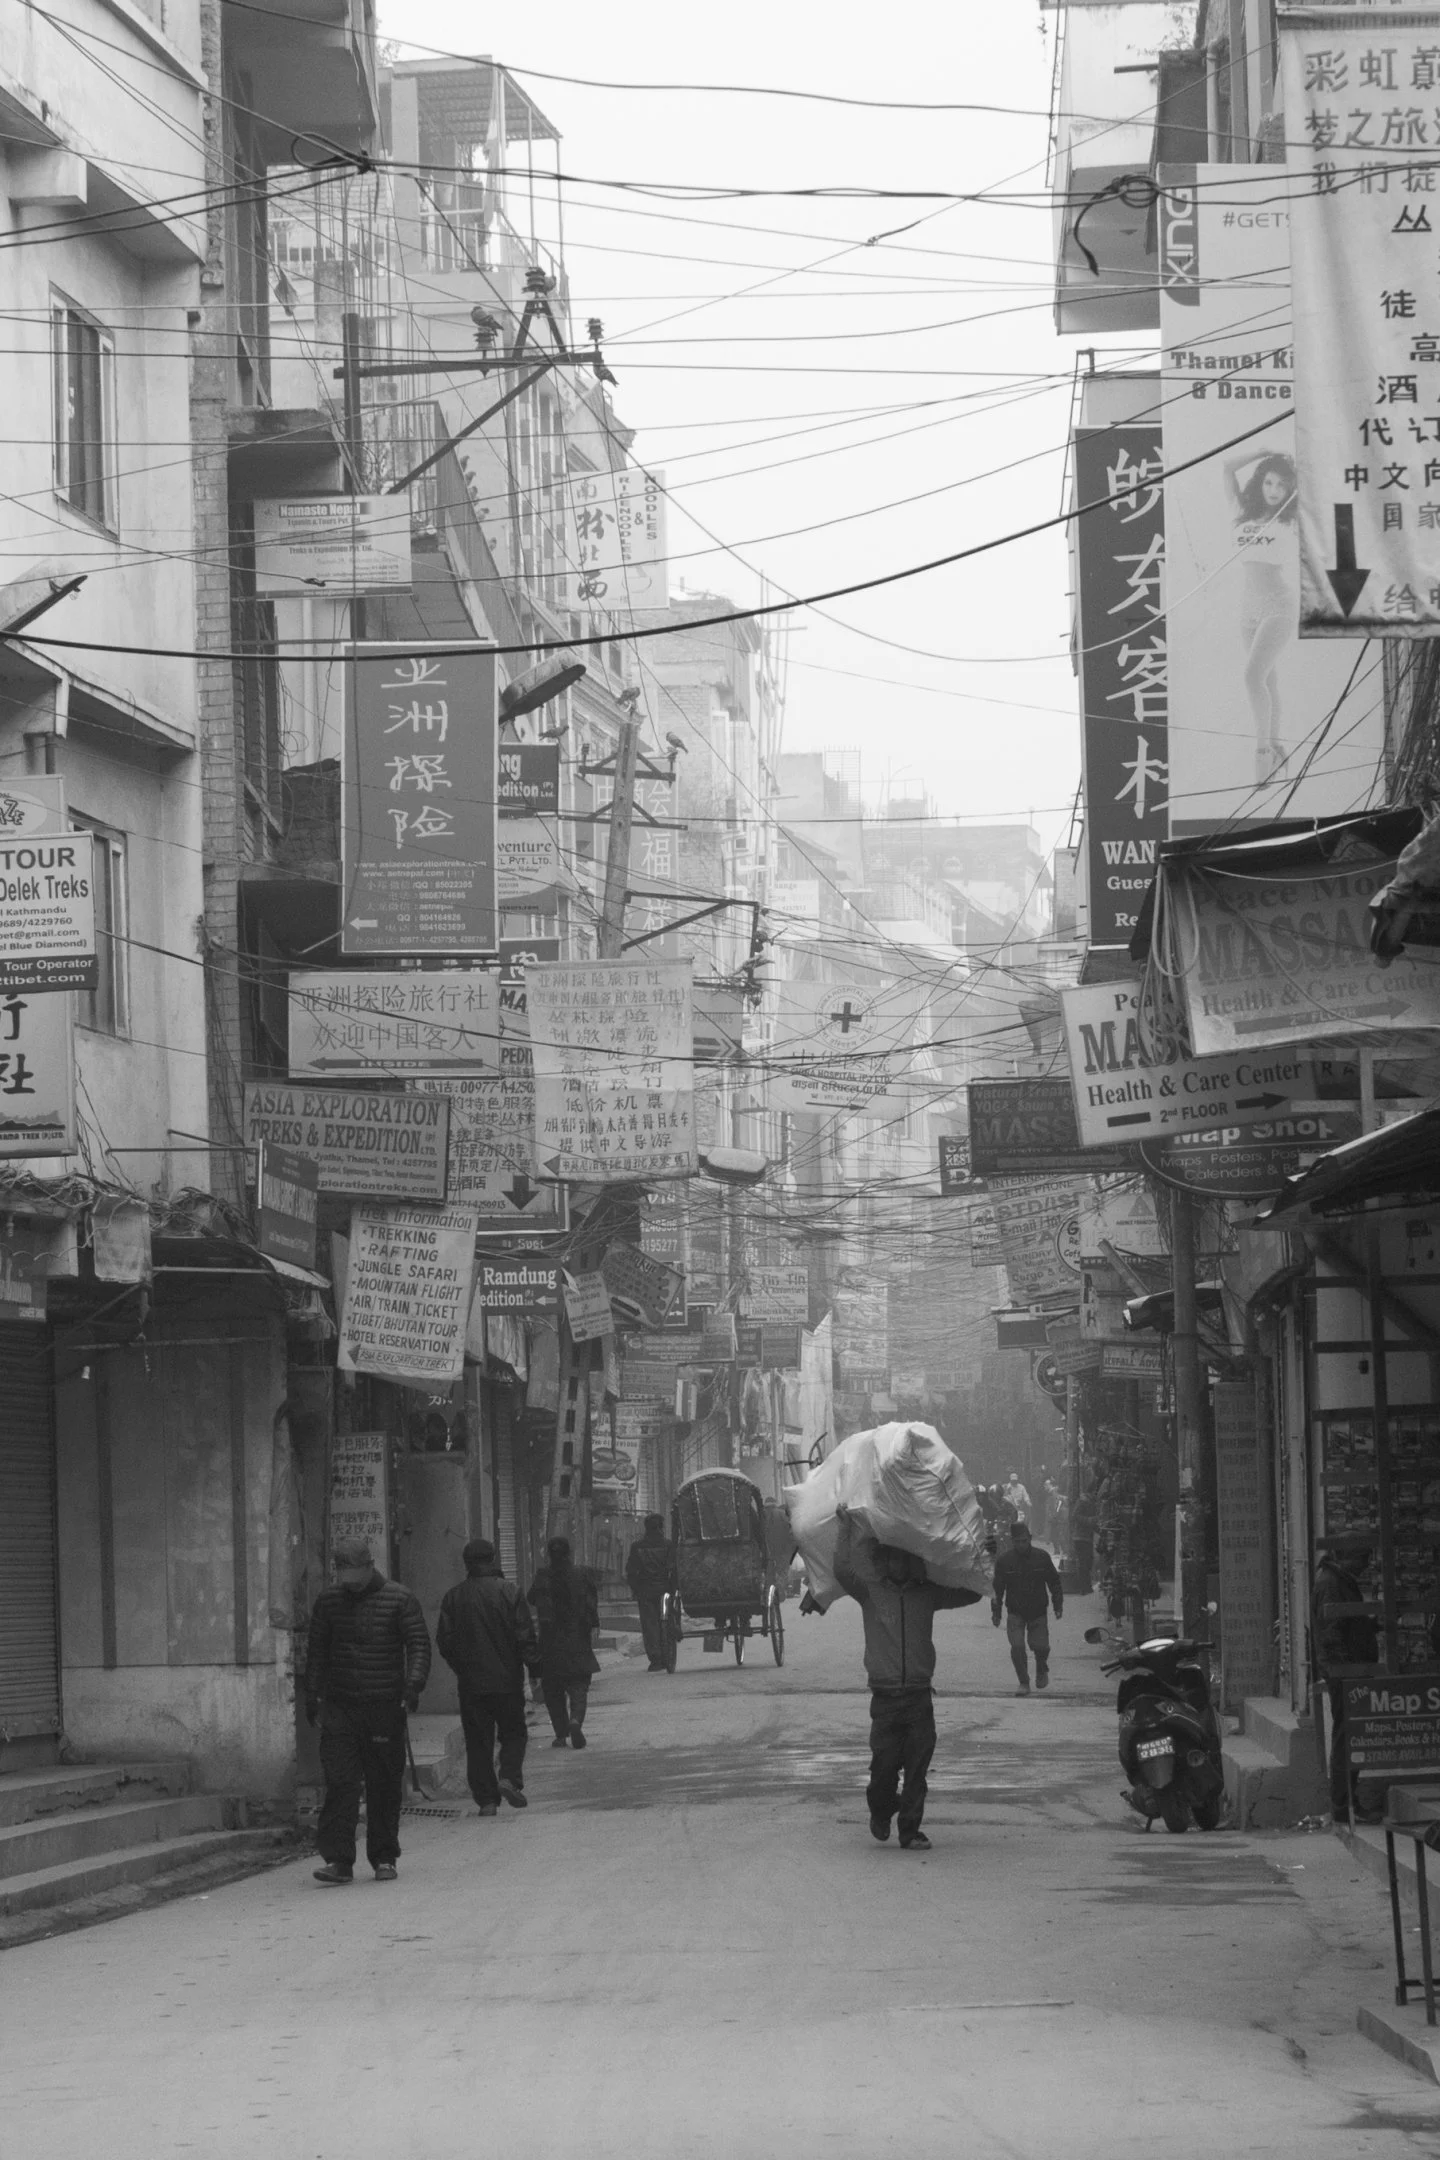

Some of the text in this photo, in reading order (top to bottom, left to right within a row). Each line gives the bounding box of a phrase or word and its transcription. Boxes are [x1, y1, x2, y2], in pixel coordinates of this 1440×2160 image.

[1305, 107, 1440, 151] 梦之旅
[1391, 204, 1432, 233] 丛
[1380, 289, 1417, 319] 徒
[1170, 351, 1262, 370] Thamel
[1217, 381, 1292, 400] Dance
[280, 504, 327, 517] Namaste
[0, 847, 76, 870] TOUR
[1101, 840, 1156, 865] WAN
[44, 874, 89, 899] Treks
[6, 907, 67, 916] Kathmandu
[35, 939, 88, 949] Diamond)
[1199, 906, 1375, 984] MASSA
[4, 960, 94, 971] Tour Operator
[299, 983, 490, 1013] 亚洲探险旅行社
[1202, 971, 1440, 1016] Health & Care Center
[311, 1022, 476, 1052] 欢迎中国客人
[1087, 1062, 1301, 1106] Health & Care Center
[250, 1088, 441, 1127] ASIA EXPLORATION
[1181, 1102, 1229, 1120] FLOOR
[250, 1119, 303, 1146] TREKS
[306, 1122, 319, 1147] &
[323, 1124, 422, 1154] EXPEDITION
[1184, 1166, 1262, 1181] Calenders
[393, 1210, 472, 1230] Information
[1000, 1220, 1037, 1238] E-mail
[368, 1225, 437, 1245] TREKKING
[367, 1243, 439, 1262] RAFTING
[357, 1259, 458, 1282] JUNGLE SAFARI
[483, 1266, 557, 1290] Ramdung
[356, 1277, 463, 1301] MOUNTAIN FLIGHT
[414, 1302, 459, 1321] TICKET
[346, 1329, 452, 1355] HOTEL RESERVATION
[427, 1323, 459, 1339] TOUR
[1347, 1686, 1369, 1704] The
[1370, 1690, 1421, 1715] Map
